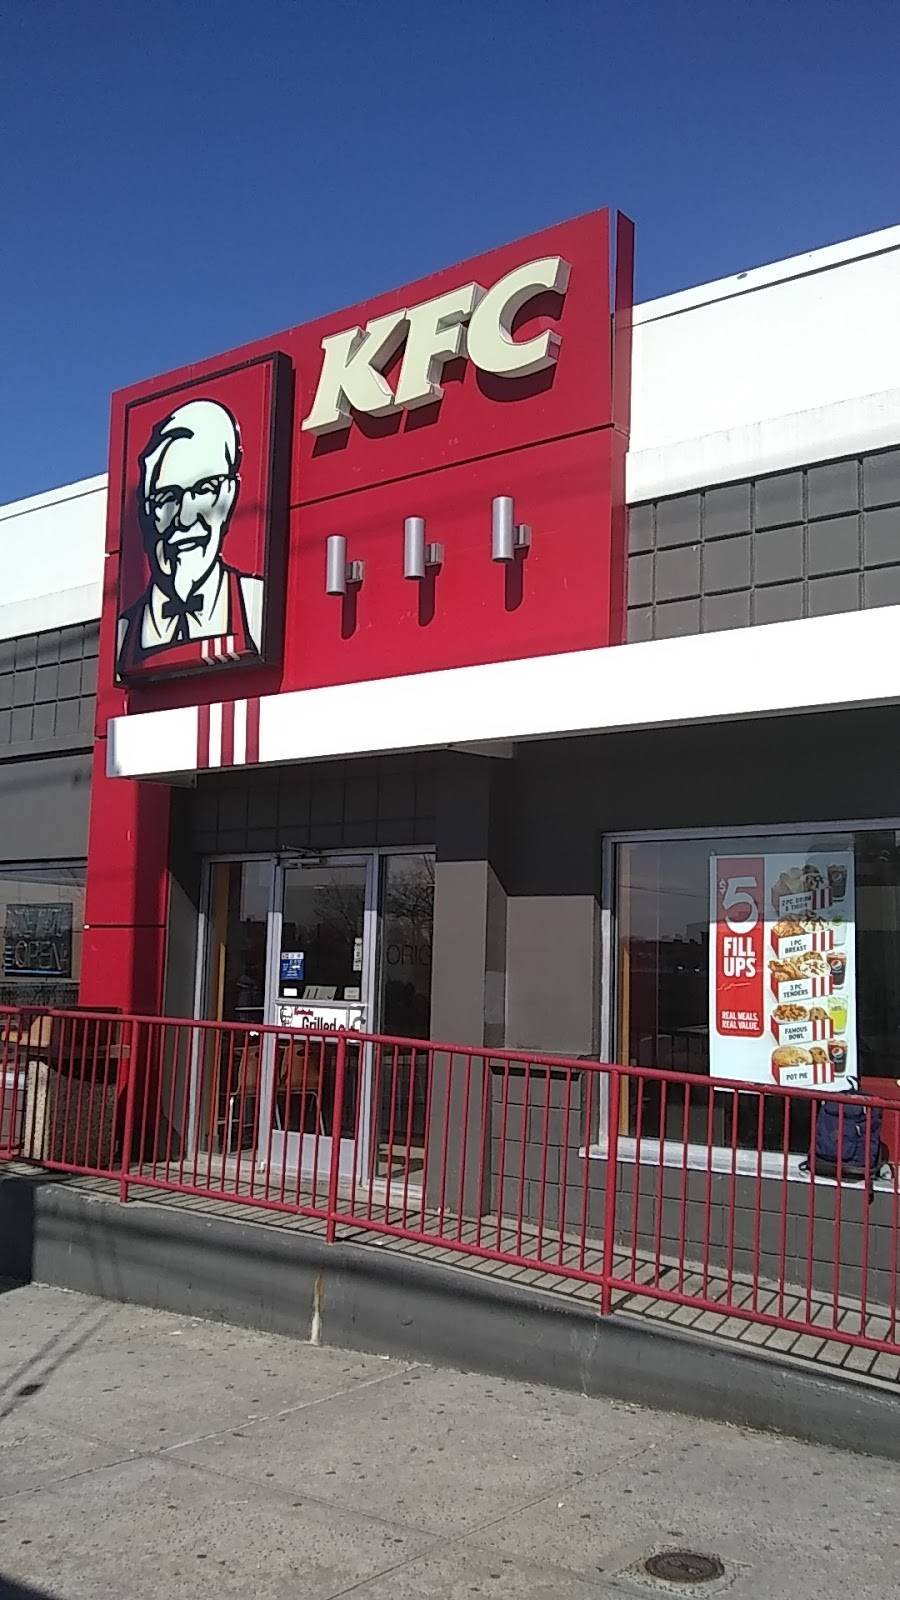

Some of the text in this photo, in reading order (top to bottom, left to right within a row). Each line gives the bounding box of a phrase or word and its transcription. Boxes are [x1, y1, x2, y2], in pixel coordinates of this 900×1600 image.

[301, 256, 571, 436] KFC
[723, 936, 756, 957] FILL
[784, 944, 807, 954] BREAST
[723, 957, 756, 977] UPS
[783, 988, 809, 998] TENDERS
[721, 1010, 737, 1020] REAL
[721, 1019, 738, 1029] REAL
[784, 1025, 808, 1035] FAMOUS
[788, 1033, 805, 1041] BOWL
